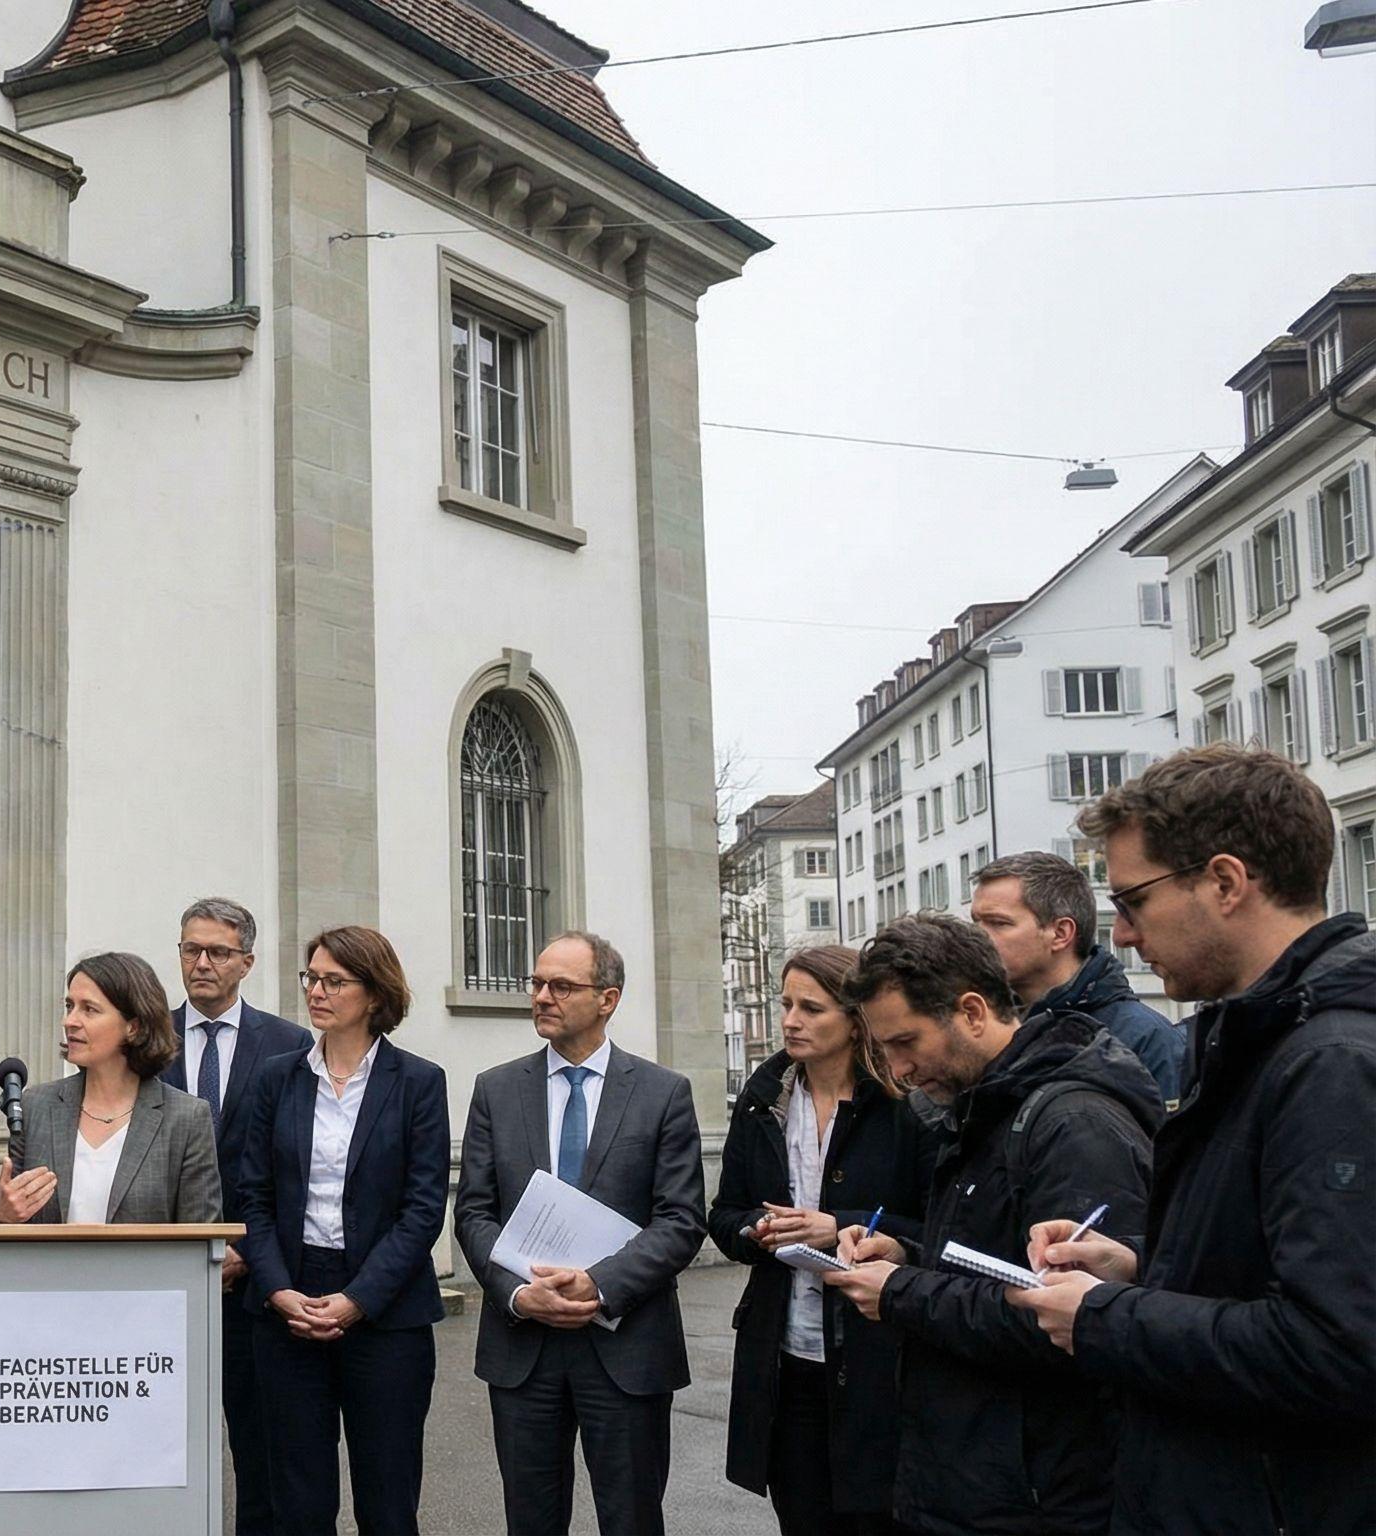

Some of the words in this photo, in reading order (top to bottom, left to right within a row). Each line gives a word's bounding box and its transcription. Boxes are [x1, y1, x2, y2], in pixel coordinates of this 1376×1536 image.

[0, 1357, 128, 1376] FACHSTELLE
[134, 1352, 174, 1374] FÜR
[0, 1377, 129, 1399] PRÄVENTION
[135, 1380, 150, 1398] &
[0, 1405, 109, 1424] BERATUNG
